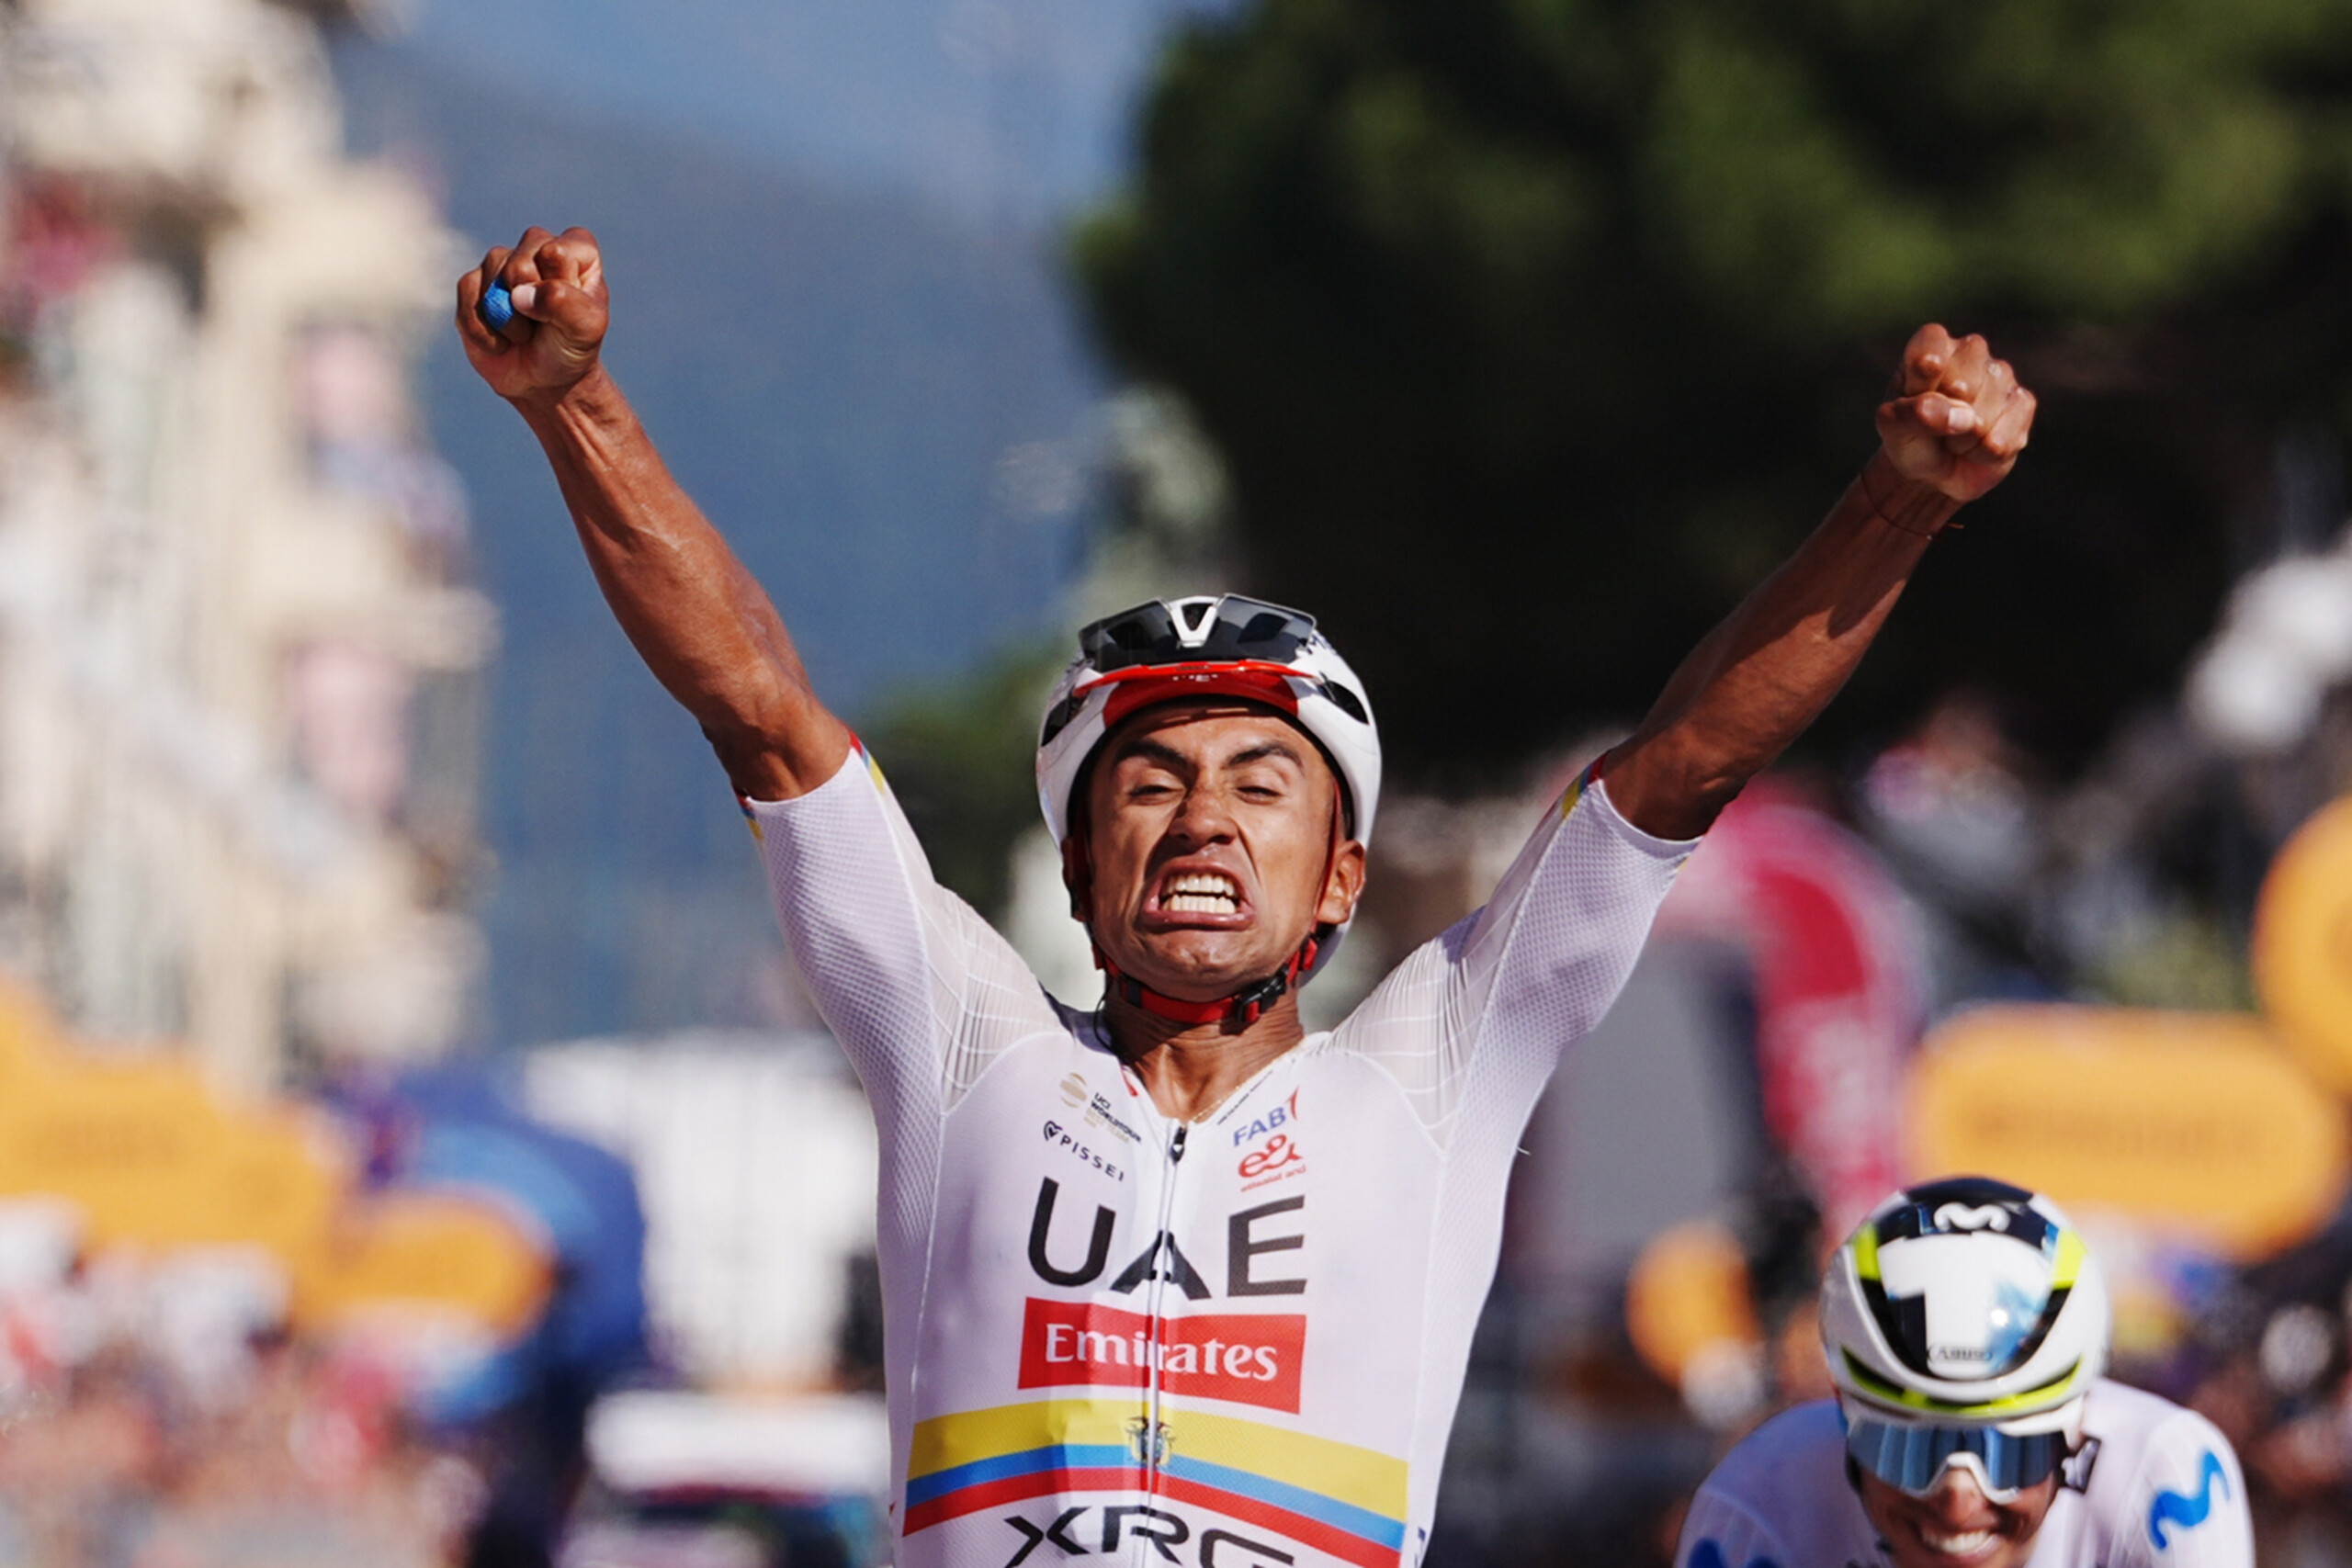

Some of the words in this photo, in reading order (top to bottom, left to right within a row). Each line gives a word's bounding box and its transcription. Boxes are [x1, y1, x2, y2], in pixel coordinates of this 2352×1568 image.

[1059, 1134, 1125, 1182] PISSEI
[1027, 1176, 1307, 1301] UAE
[1046, 1324, 1278, 1382] Emirates
